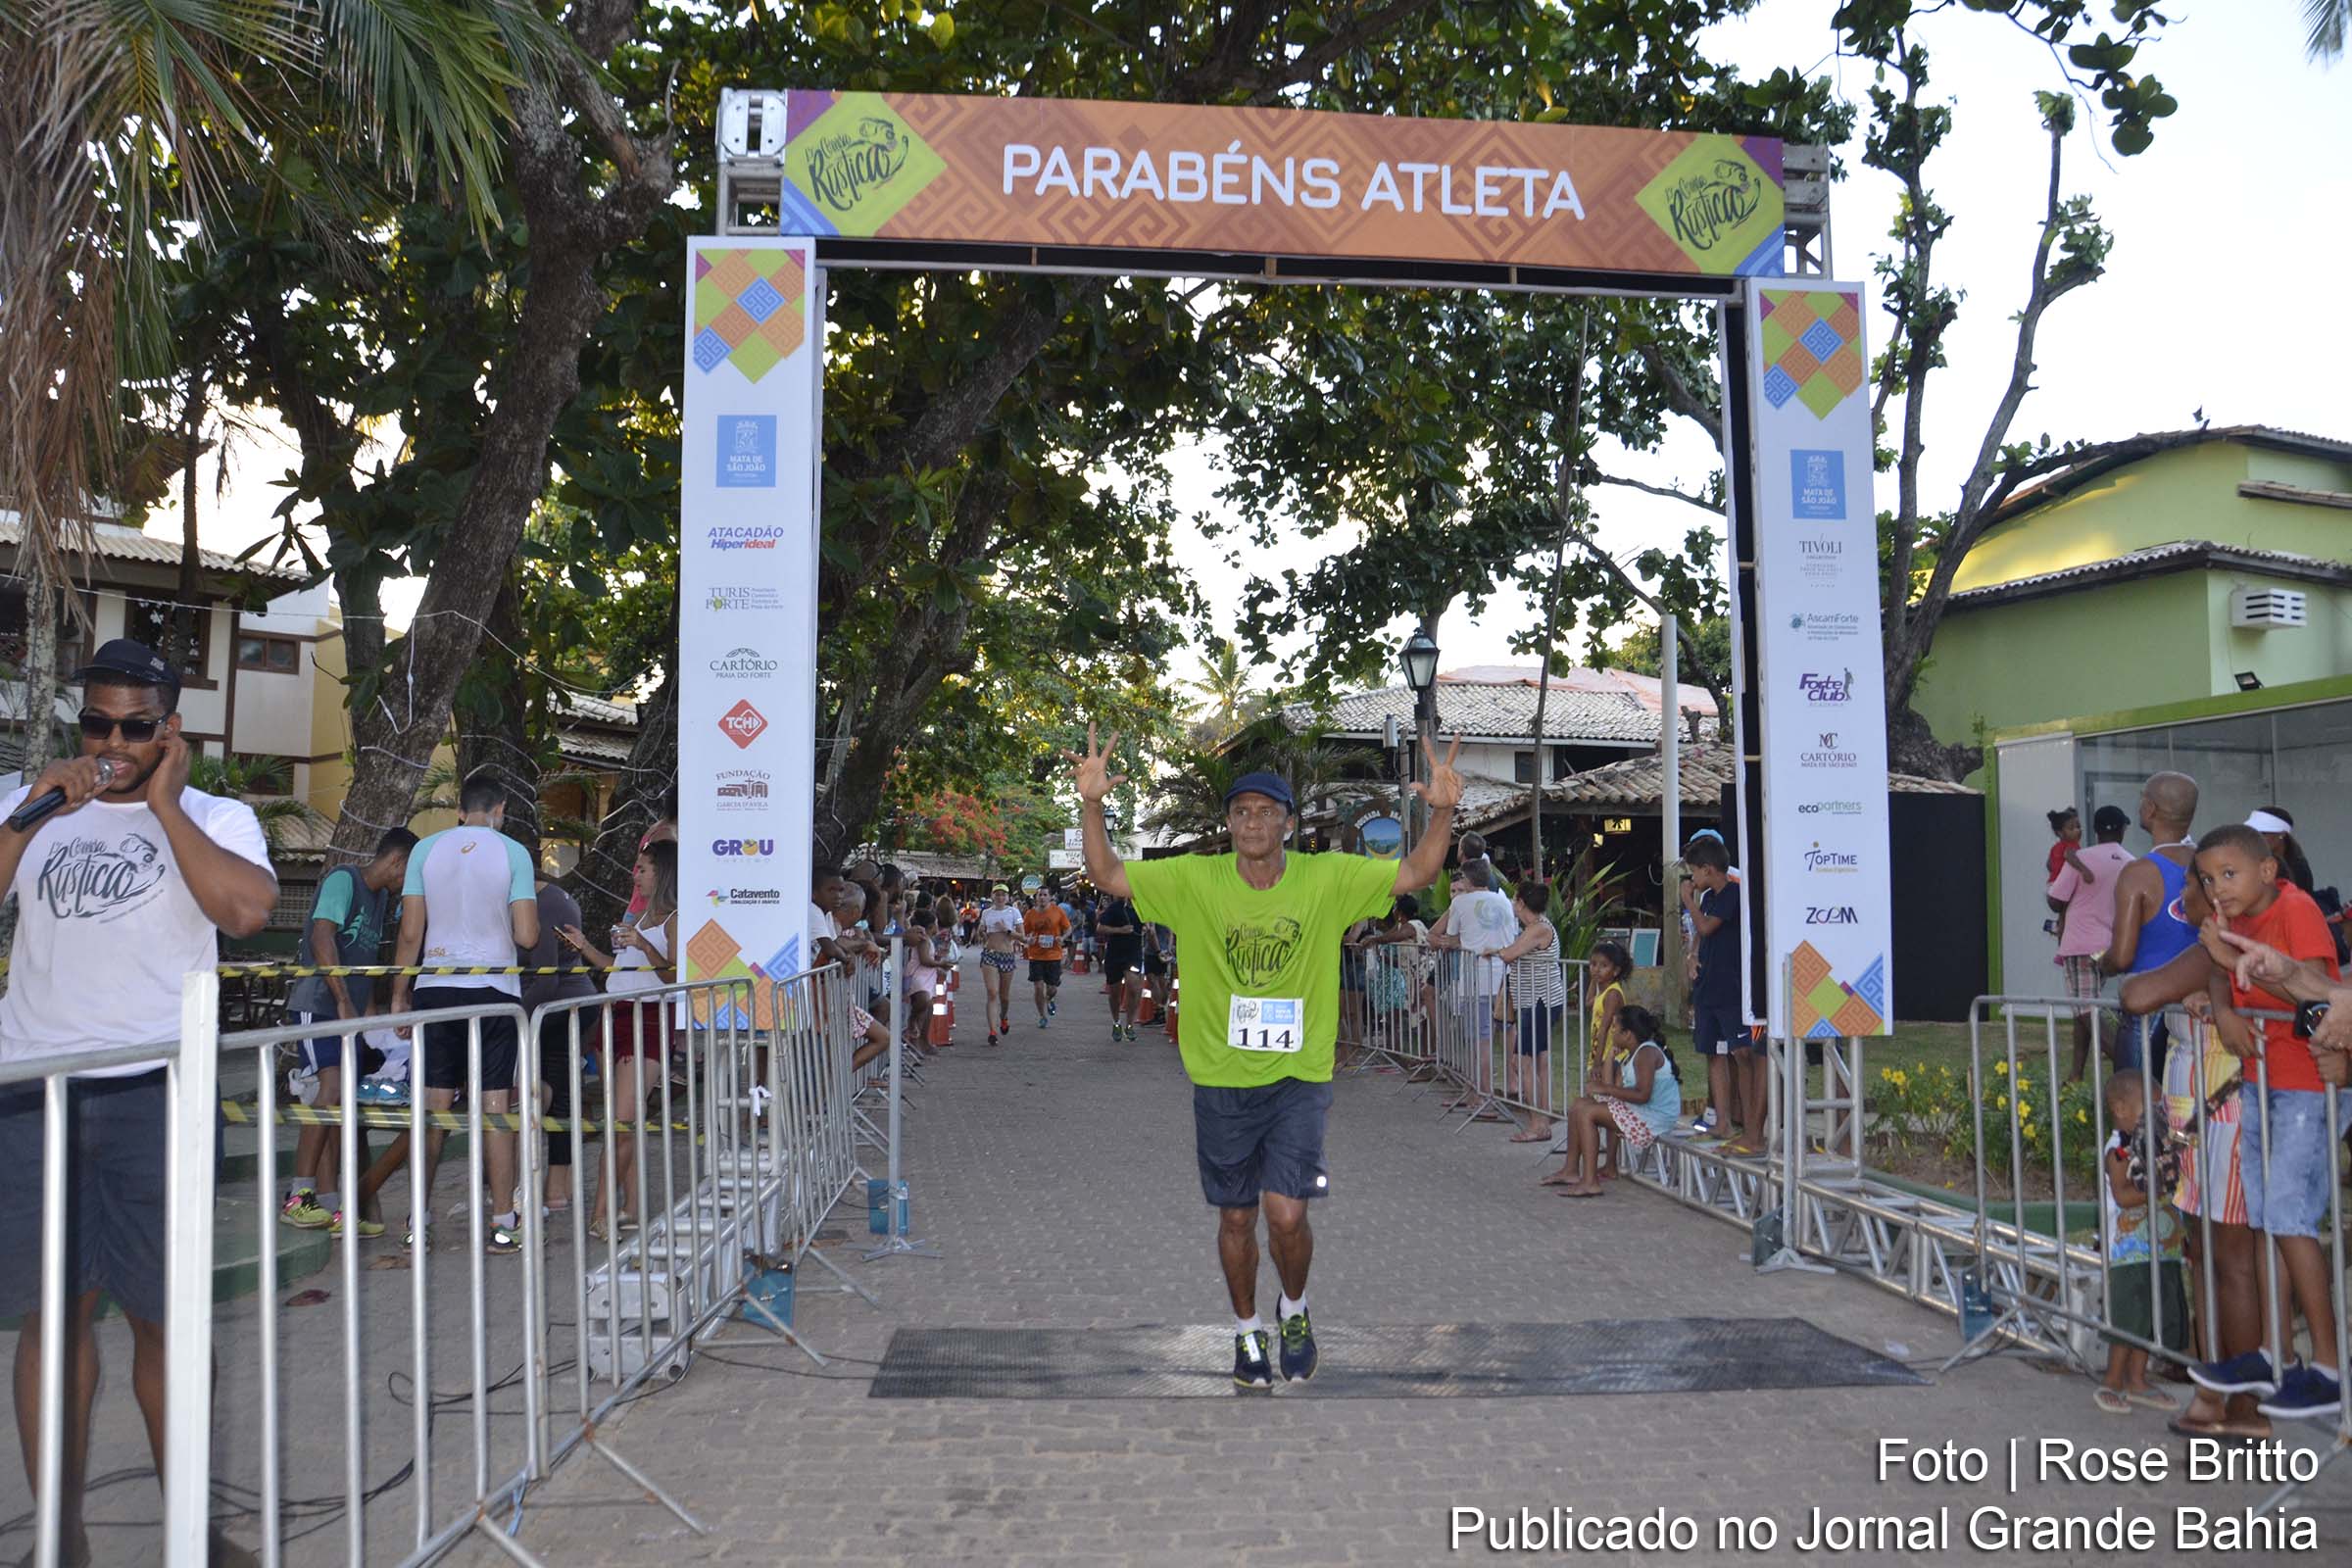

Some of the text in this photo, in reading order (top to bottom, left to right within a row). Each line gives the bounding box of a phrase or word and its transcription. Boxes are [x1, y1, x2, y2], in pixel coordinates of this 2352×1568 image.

[1003, 139, 1586, 220] PARABÉNS ATLETA
[708, 525, 784, 538] ATACADÃO
[710, 539, 776, 551] Hiperideal
[1798, 540, 1842, 555] TIVOLI
[709, 587, 751, 598] TURIS
[709, 659, 778, 671] CARTÓRIO
[1799, 673, 1843, 690] Forte
[1807, 689, 1846, 702] Club
[725, 715, 753, 730] TCH
[1800, 751, 1857, 762] CARTÓRIO
[715, 769, 771, 781] FUNDAÇÃO
[730, 888, 780, 899] Catavento
[1805, 906, 1858, 924] ZOOM
[1237, 1027, 1294, 1050] 114
